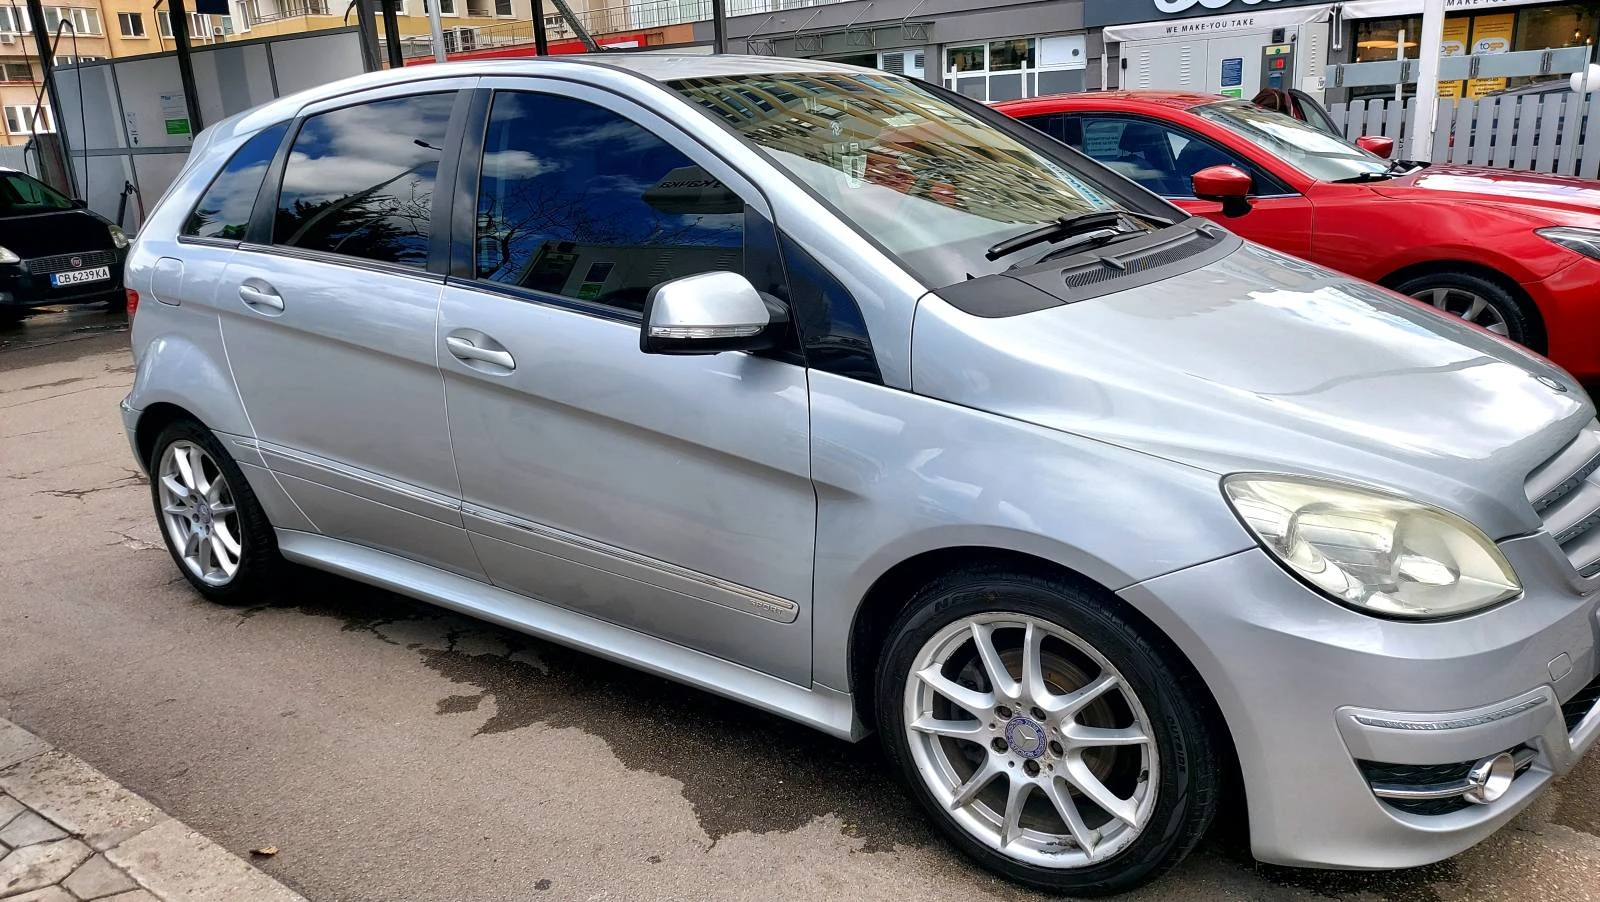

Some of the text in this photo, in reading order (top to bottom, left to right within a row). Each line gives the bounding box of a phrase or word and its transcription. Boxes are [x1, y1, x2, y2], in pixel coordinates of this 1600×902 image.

[1166, 18, 1254, 34] WE MAKE-YOU TAKE
[58, 268, 108, 284] CB 6239 KA
